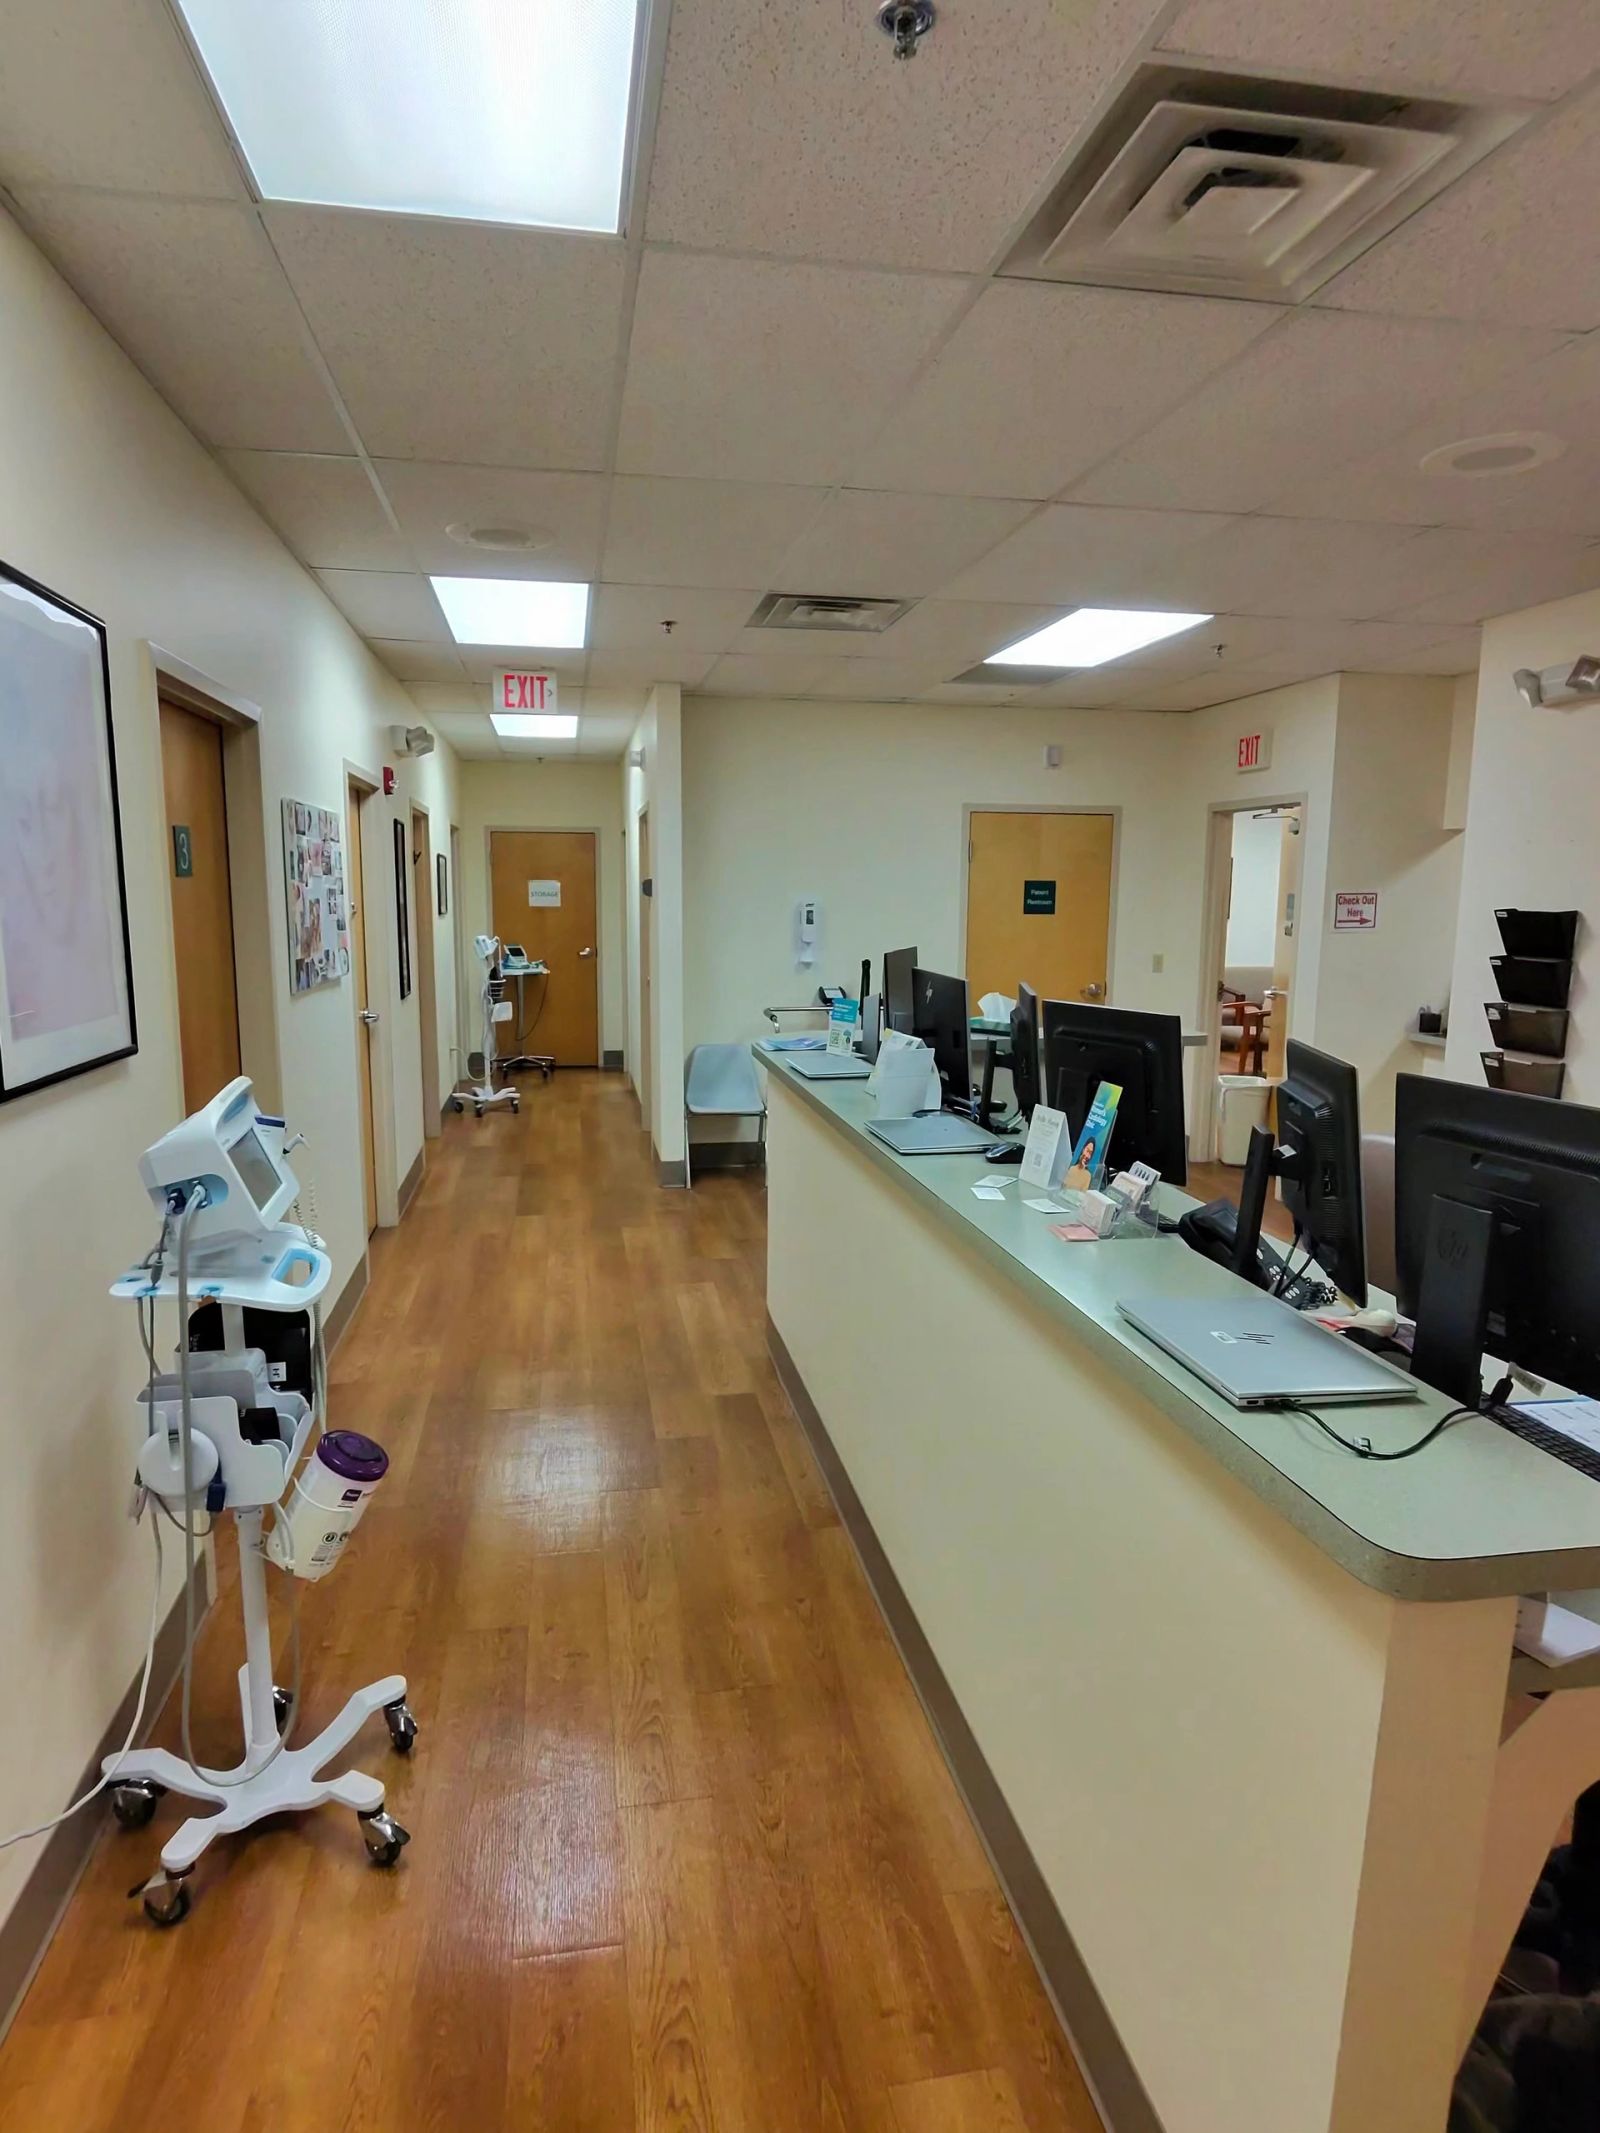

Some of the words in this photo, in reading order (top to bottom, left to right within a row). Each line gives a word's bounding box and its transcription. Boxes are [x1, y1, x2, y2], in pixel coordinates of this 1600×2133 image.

[503, 674, 548, 709] EXIT
[1238, 735, 1261, 768] EXIT
[179, 832, 189, 870] 3
[1338, 896, 1360, 906] Check
[1362, 895, 1375, 905] Out
[1347, 908, 1364, 917] Here
